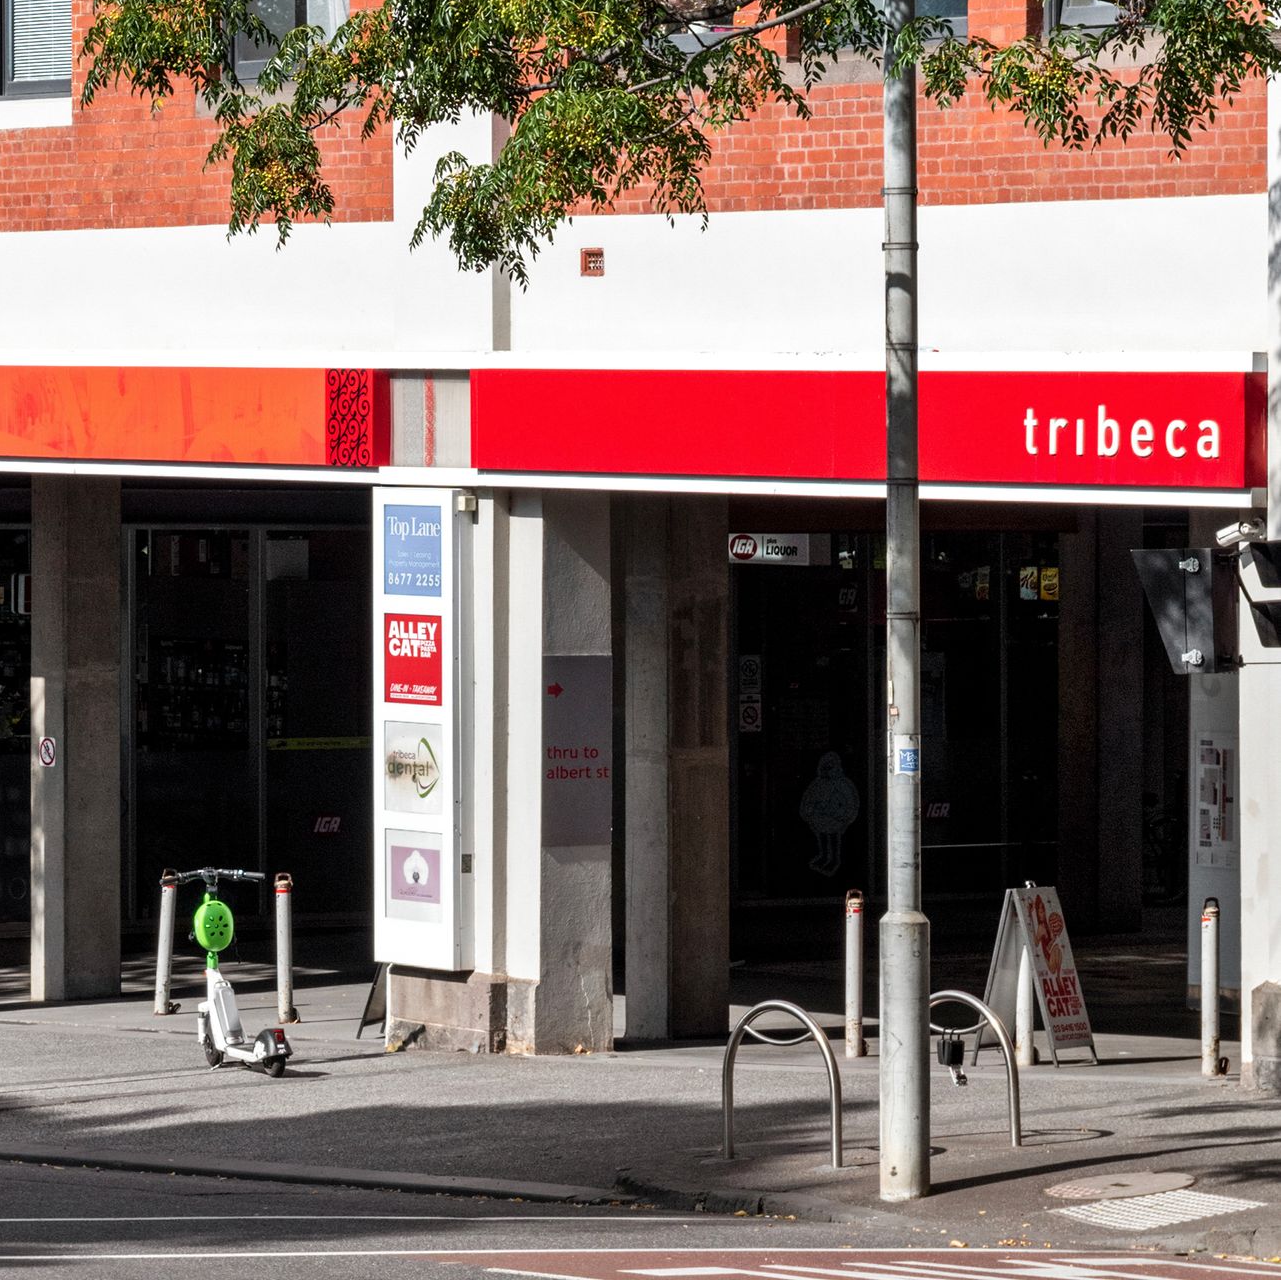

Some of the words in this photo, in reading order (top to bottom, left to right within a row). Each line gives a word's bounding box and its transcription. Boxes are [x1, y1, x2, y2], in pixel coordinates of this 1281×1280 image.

[1023, 404, 1221, 459] tribeca
[387, 516, 410, 541] Top
[412, 517, 441, 537] Lane
[732, 539, 755, 554] IGA
[766, 545, 798, 557] LIQUOR
[388, 572, 412, 585] 8677
[415, 573, 441, 587] 2255
[388, 620, 438, 641] ALLEY
[388, 638, 421, 657] CAT
[393, 749, 417, 760] tribeca
[546, 746, 578, 759] thru
[583, 747, 599, 759] to
[387, 755, 429, 776] dental
[546, 766, 591, 779] albert
[596, 767, 609, 778] st
[926, 803, 951, 818] IGA
[314, 816, 341, 833] IGA
[1043, 976, 1077, 997] ALLEY
[1047, 997, 1071, 1018] CAT
